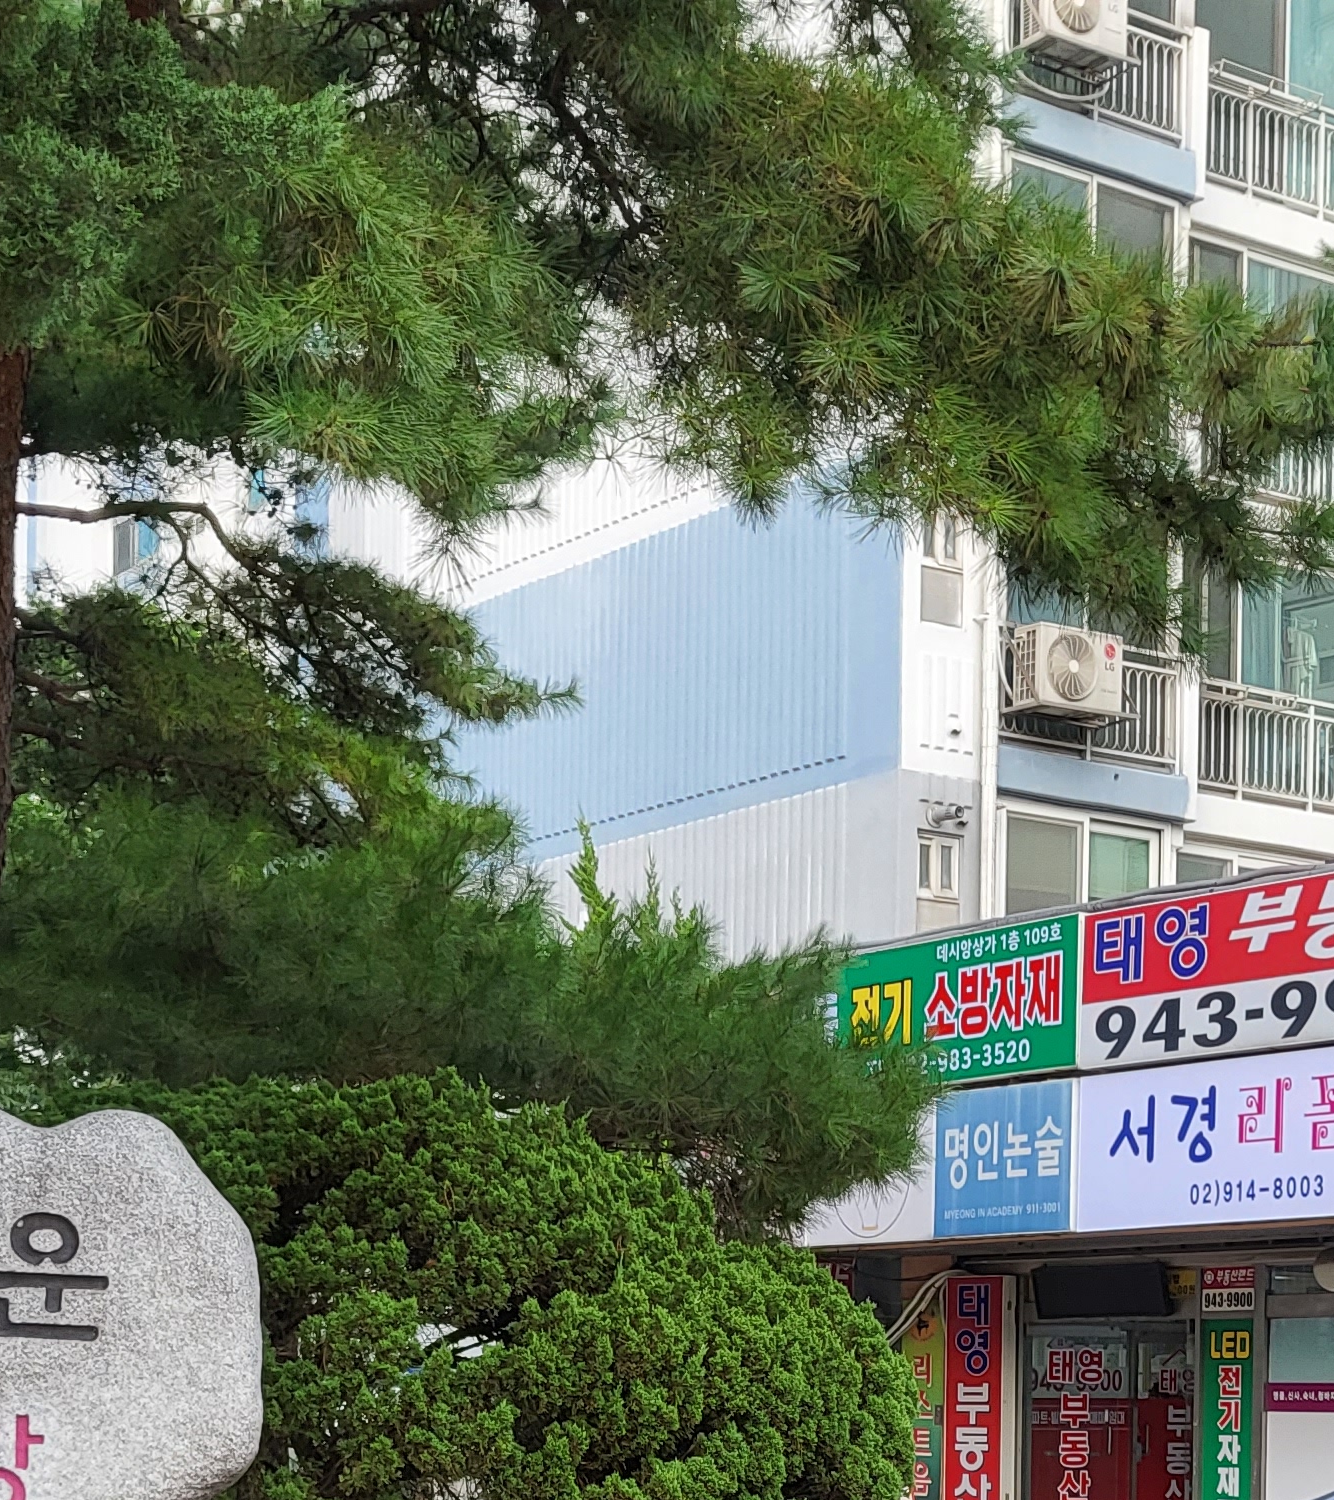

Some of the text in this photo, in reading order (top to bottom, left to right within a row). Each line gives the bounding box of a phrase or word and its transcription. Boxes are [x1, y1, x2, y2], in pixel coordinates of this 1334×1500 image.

[1104, 661, 1115, 672] LG
[936, 922, 1063, 963] 데시앙상가 1층 109호
[1093, 902, 1209, 985] 태영
[850, 949, 1065, 1046] 전기 소방자재
[1109, 1084, 1217, 1163] 서경
[944, 1115, 1064, 1191] 명인논술
[1189, 1174, 1325, 1207] 02)914-8003
[944, 1207, 976, 1220] MYEONG
[978, 1208, 985, 1218] IN
[987, 1205, 1023, 1217] ACADEMY
[1204, 1291, 1253, 1308] 943-9900
[955, 1283, 991, 1377] 태영
[1210, 1331, 1250, 1359] LED
[1047, 1348, 1104, 1383] 태영
